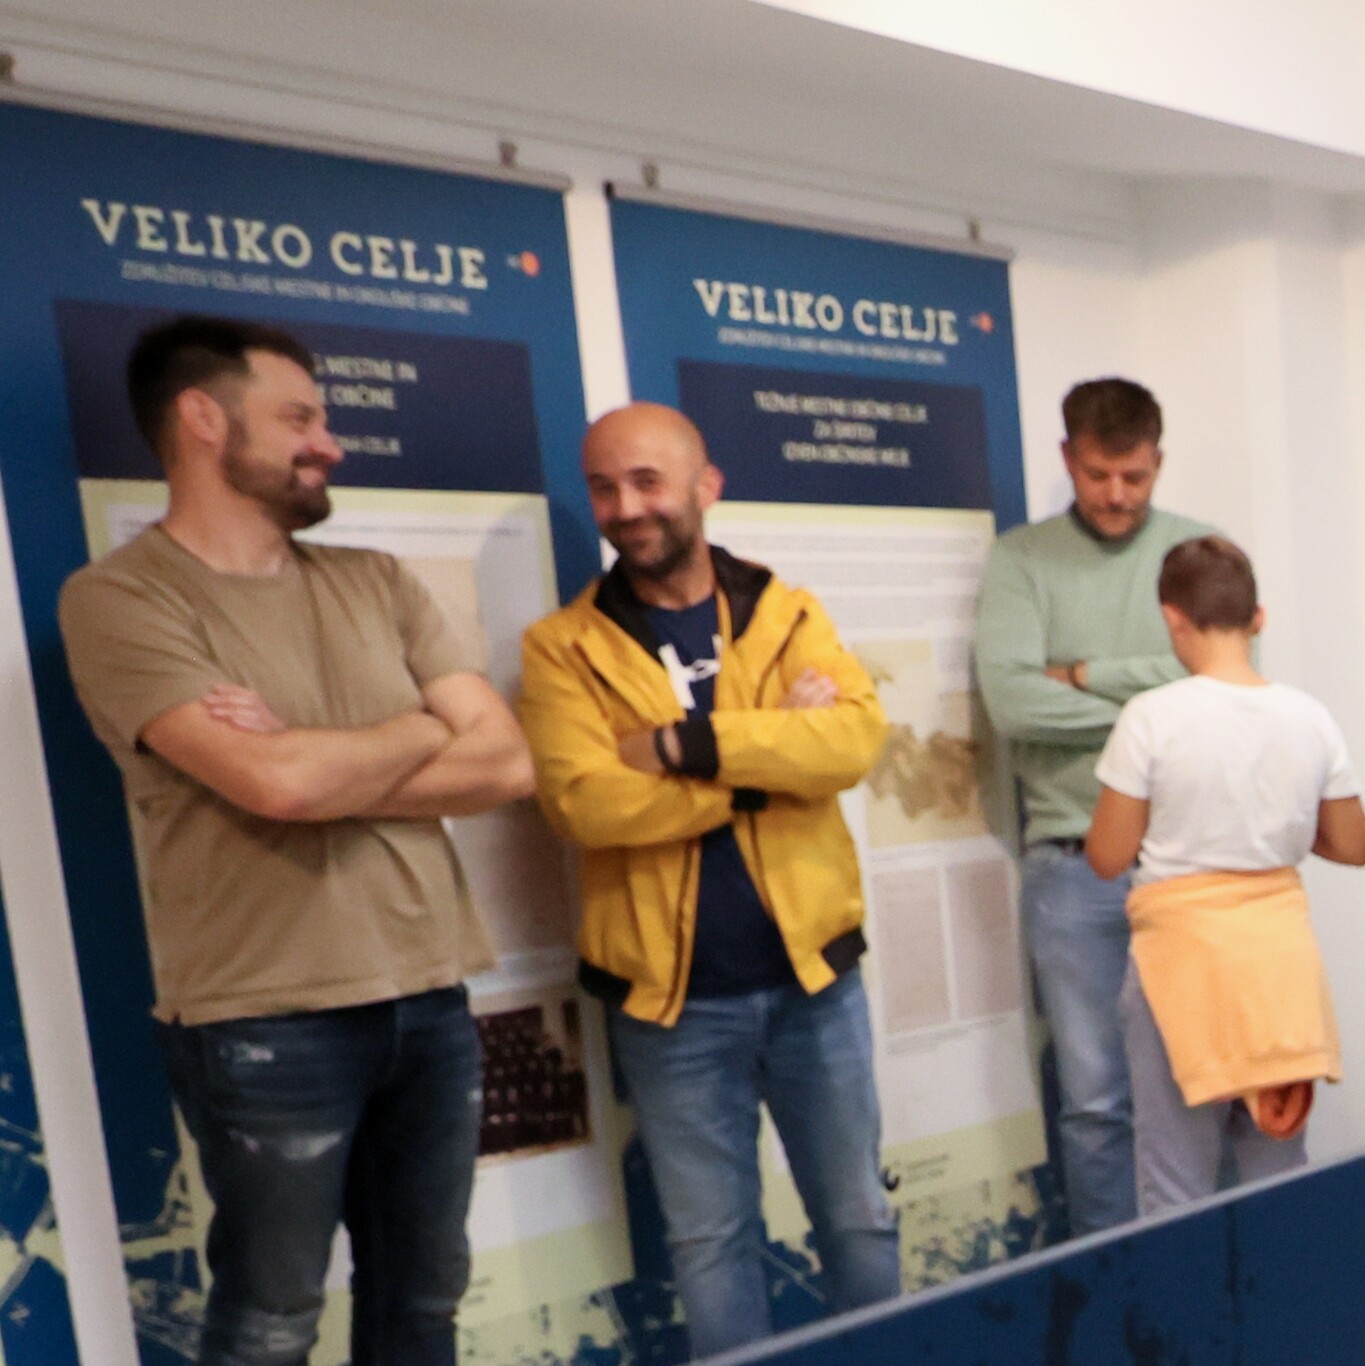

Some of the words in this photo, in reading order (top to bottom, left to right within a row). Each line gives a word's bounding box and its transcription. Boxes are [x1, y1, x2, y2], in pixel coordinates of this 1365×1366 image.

[82, 198, 312, 268] VELIKO
[331, 232, 487, 290] CELJE
[693, 279, 843, 332] VELIKO
[853, 299, 959, 345] CELJE
